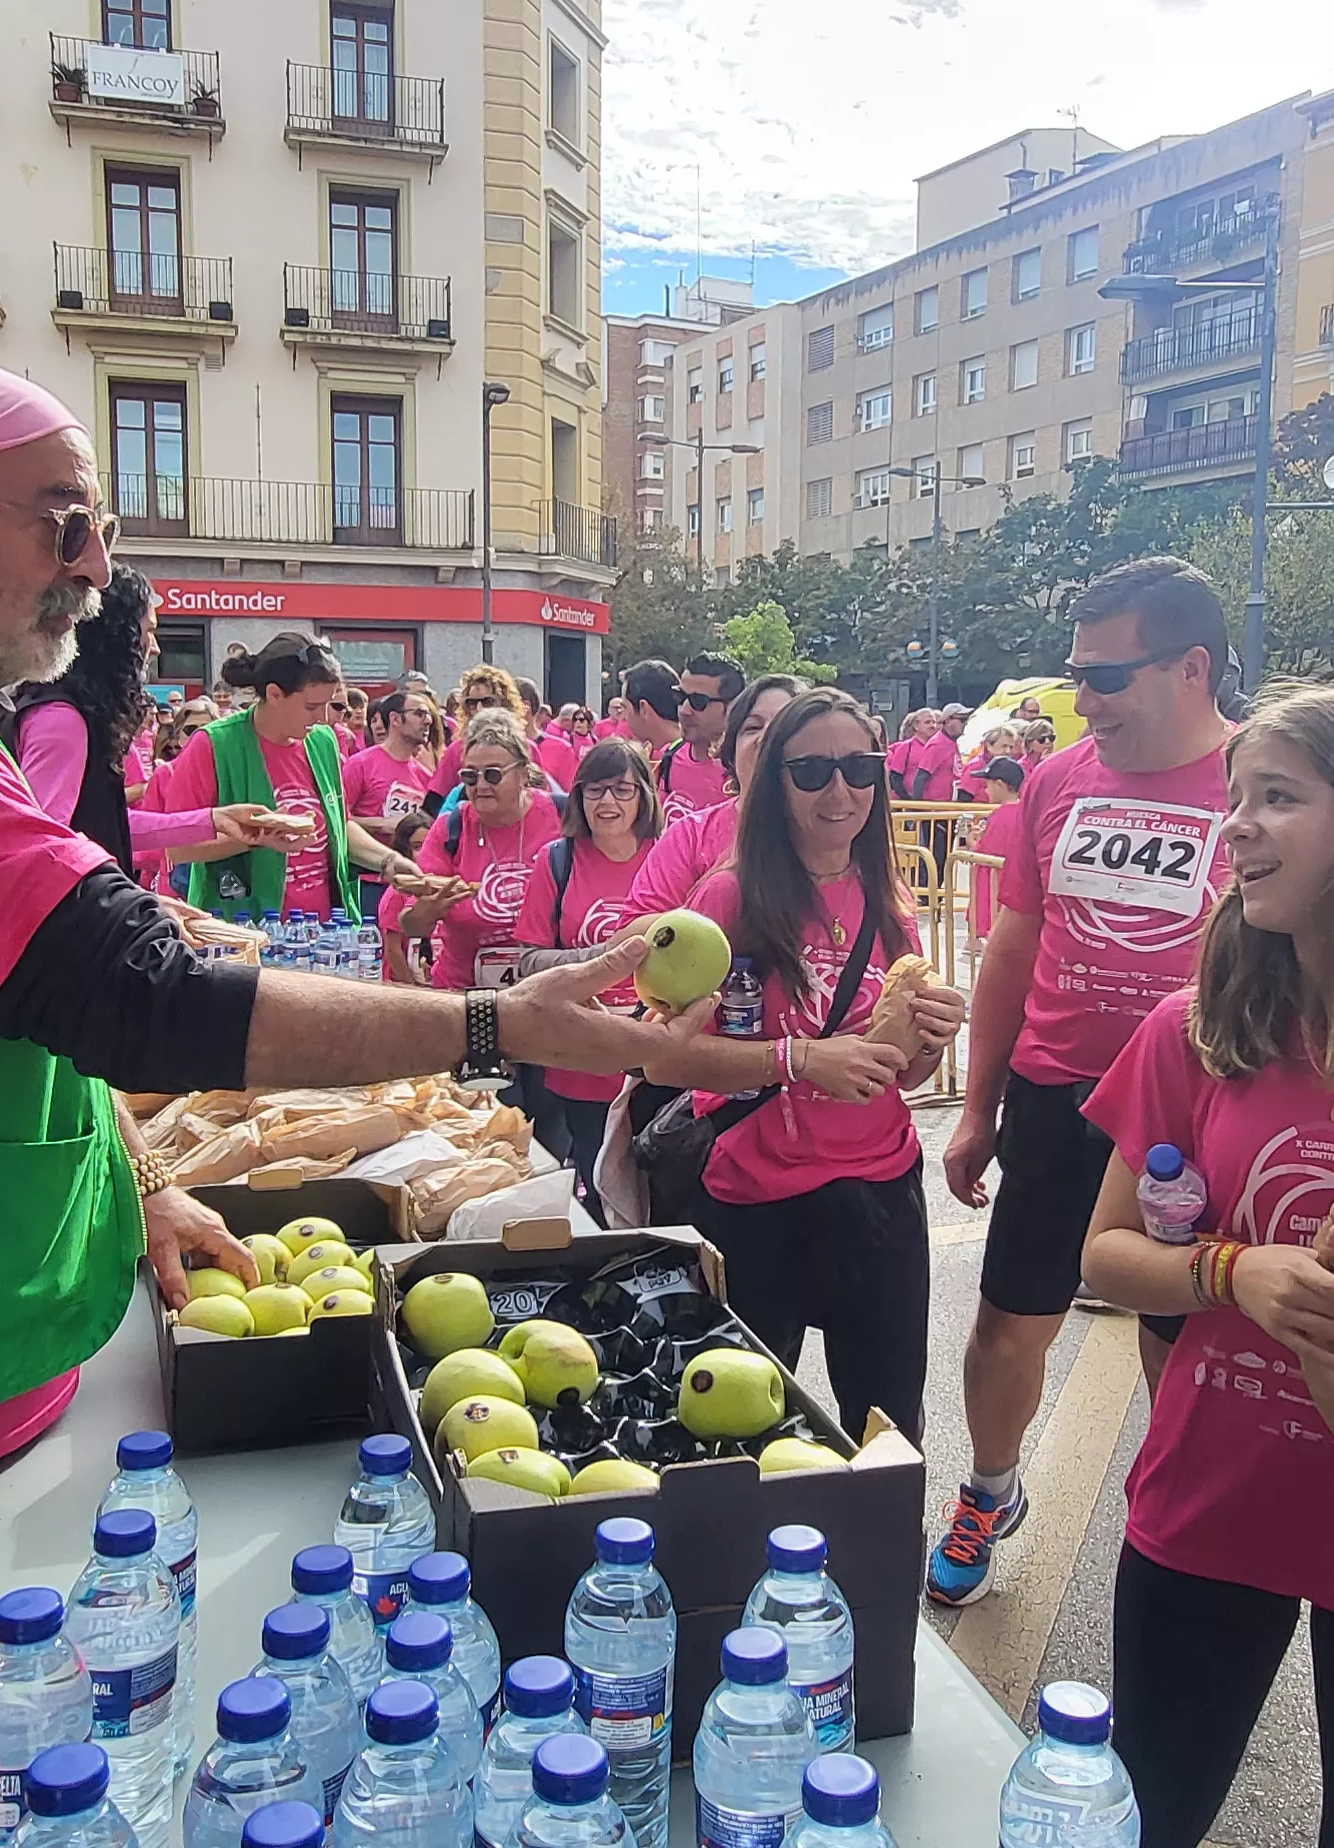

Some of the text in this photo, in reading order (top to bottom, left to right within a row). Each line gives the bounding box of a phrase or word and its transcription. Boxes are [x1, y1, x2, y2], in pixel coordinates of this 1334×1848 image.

[167, 588, 286, 611] Santander
[553, 602, 595, 627] Santander
[390, 798, 421, 814] 241
[1125, 810, 1161, 821] HUESCA
[1083, 815, 1201, 837] CONTRA EL CÁNCER
[1067, 829, 1197, 882] 2042
[493, 1290, 534, 1314] 20
[389, 1580, 408, 1596] AGU
[815, 1681, 849, 1708] MINERAL
[809, 1701, 842, 1721] ATURAL
